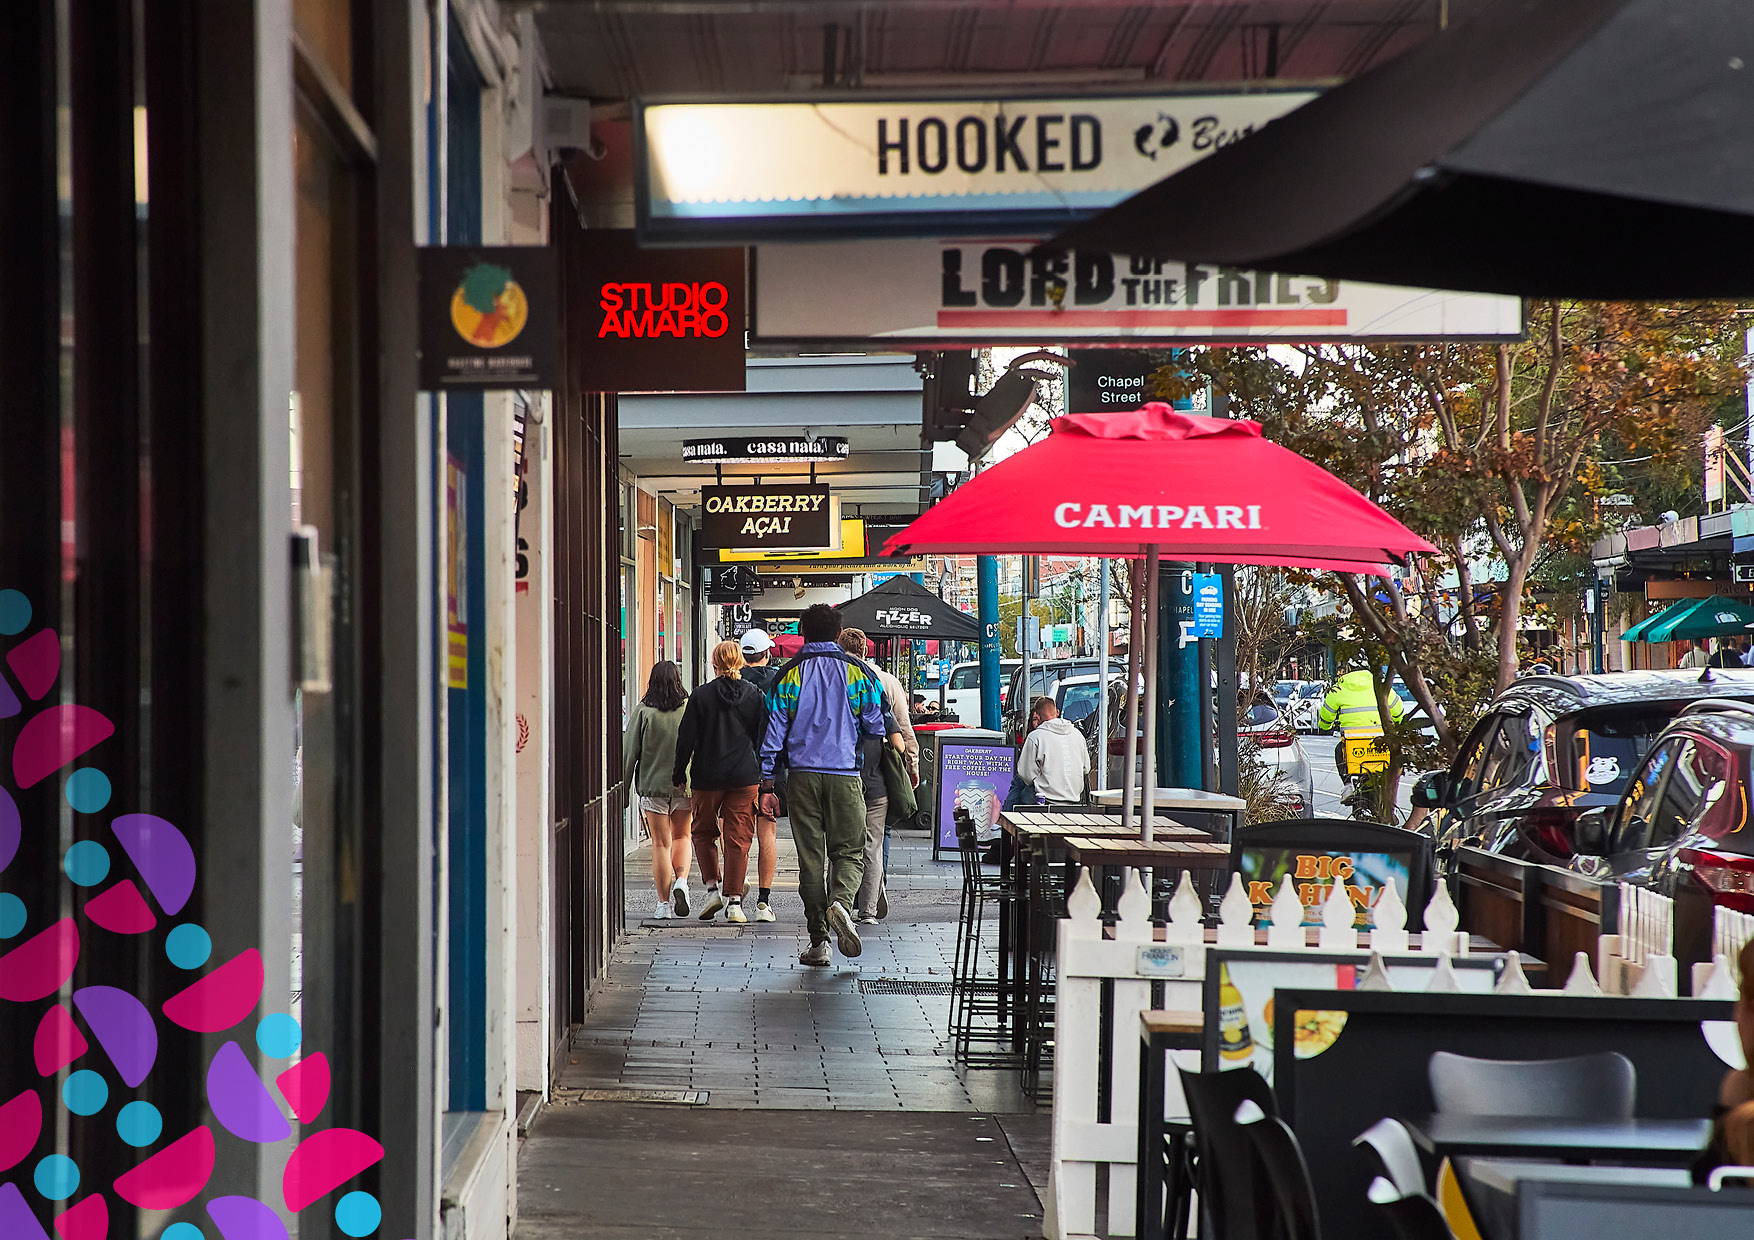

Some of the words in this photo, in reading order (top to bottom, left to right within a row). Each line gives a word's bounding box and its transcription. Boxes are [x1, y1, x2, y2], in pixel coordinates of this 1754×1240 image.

[877, 113, 1103, 175] HOOKED
[942, 247, 1116, 307] LORD
[599, 281, 729, 311] STUDIO
[1121, 278, 1179, 306] THE
[597, 309, 729, 338] AMARO
[1097, 375, 1145, 389] Chapel
[1101, 391, 1142, 403] Street
[747, 442, 787, 454] casa
[706, 494, 826, 513] OAKBERRY
[740, 516, 792, 538] AÇAI
[1053, 502, 1263, 530] CAMPARI
[876, 609, 933, 625] FIZZER
[1294, 855, 1356, 880] BIG
[1141, 951, 1179, 961] FRANKLIN
